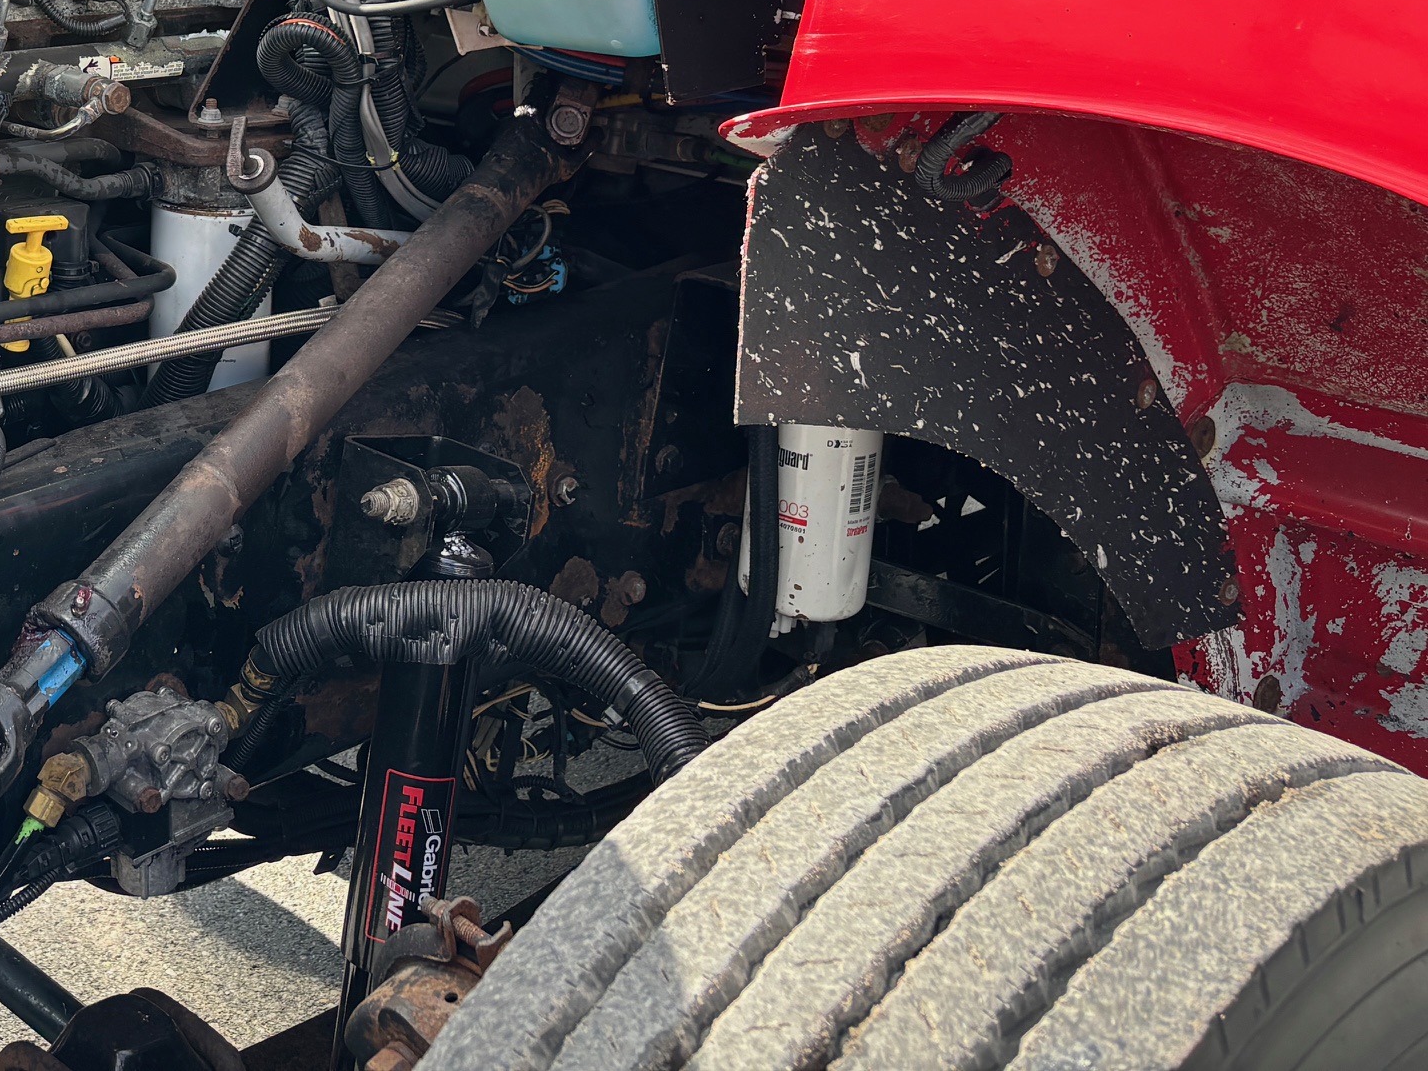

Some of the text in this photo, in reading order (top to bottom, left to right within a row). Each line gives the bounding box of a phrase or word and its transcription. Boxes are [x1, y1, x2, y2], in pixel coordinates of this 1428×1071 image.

[779, 447, 809, 470] guard
[779, 499, 809, 518] 003
[417, 834, 442, 911] Gabrie
